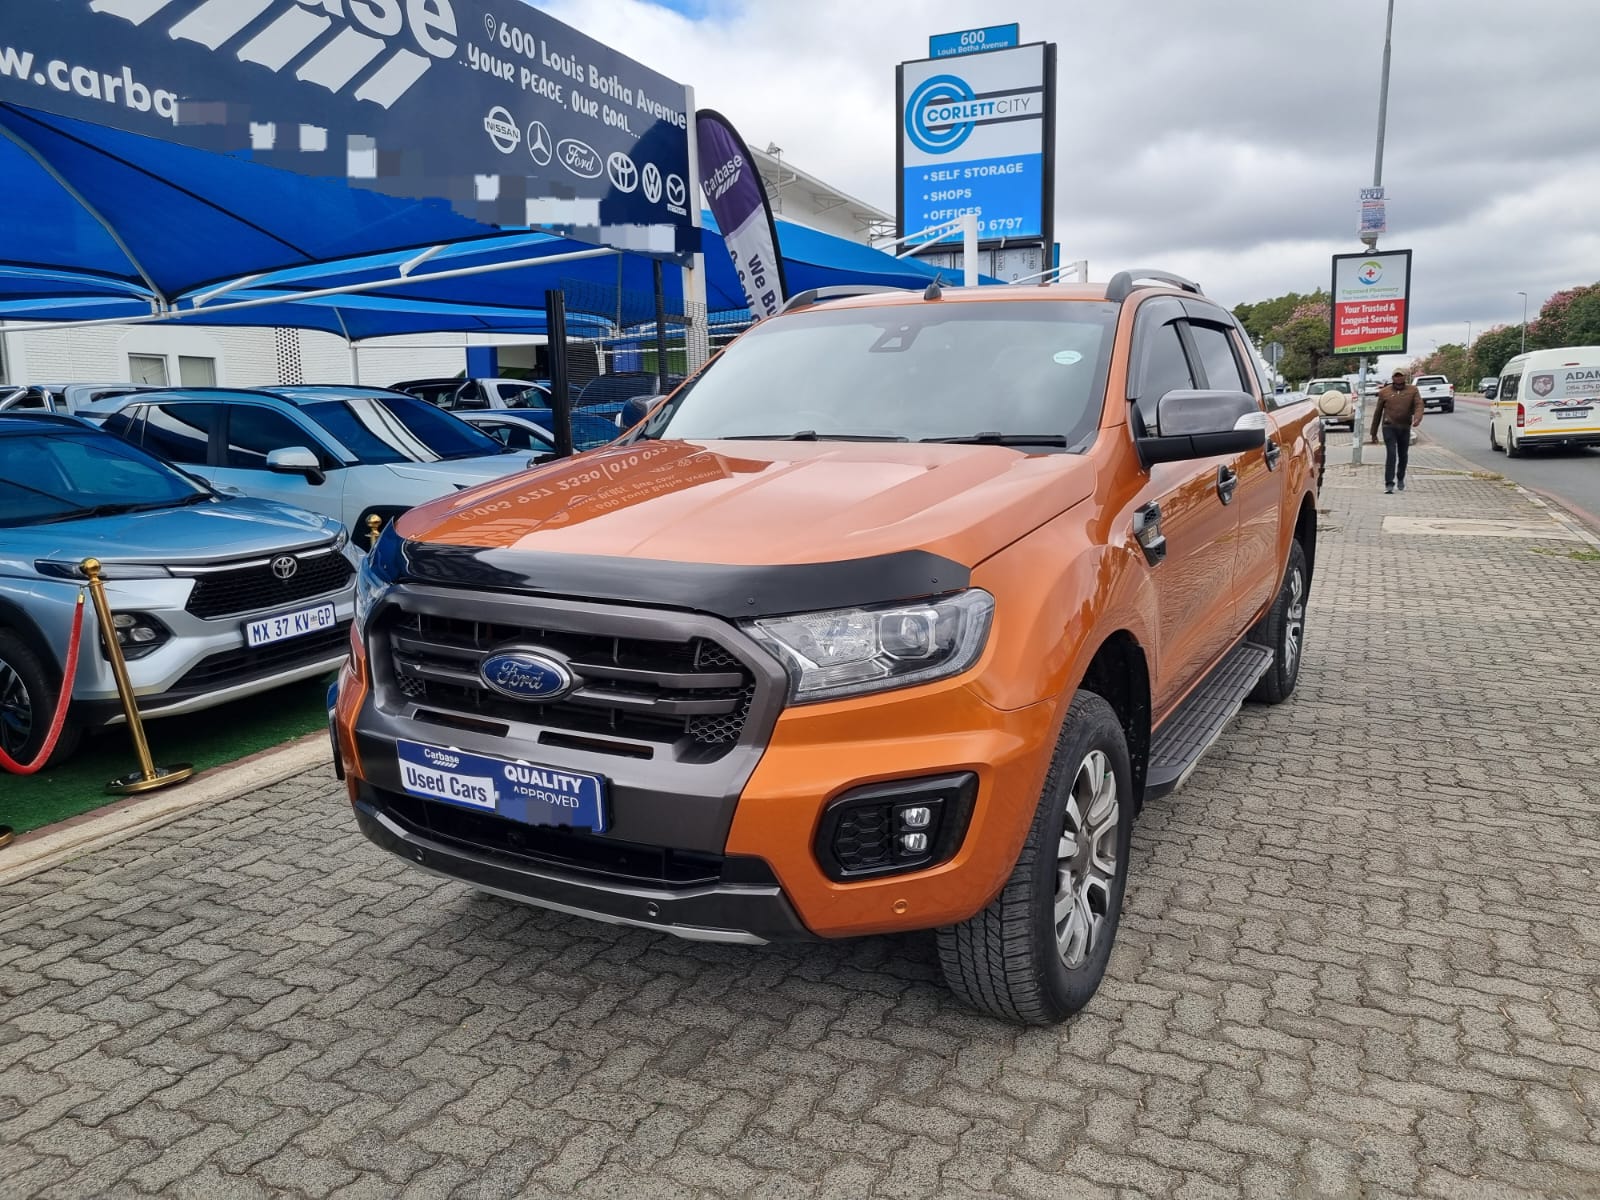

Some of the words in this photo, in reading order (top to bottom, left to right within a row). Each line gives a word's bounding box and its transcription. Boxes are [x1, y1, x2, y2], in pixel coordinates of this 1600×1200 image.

[937, 48, 956, 56] Louis
[958, 45, 979, 54] Botha
[981, 40, 1009, 49] Avenue
[960, 30, 985, 45] 600
[499, 22, 536, 59] 600
[541, 41, 585, 83] Louis
[589, 64, 633, 105] Botha
[636, 89, 687, 130] Avenue
[520, 68, 568, 110] PEACE,
[571, 91, 599, 119] OUR
[486, 120, 520, 143] NISSAN
[565, 144, 596, 173] Ford
[704, 154, 743, 197] Carbase
[930, 170, 960, 182] SELF
[964, 162, 1023, 179] STORAGE
[930, 188, 972, 202] SHOPS
[930, 206, 982, 221] OFFICES
[989, 217, 1023, 231] 6797
[748, 254, 766, 289] We
[1344, 304, 1360, 314] Your
[1361, 303, 1389, 313] Trusted
[1389, 302, 1396, 311] &
[1341, 315, 1369, 326] Longest
[1370, 314, 1399, 324] Serving
[1341, 327, 1360, 336] Local
[1361, 326, 1398, 335] Pharmacy
[252, 622, 270, 642] MX
[275, 618, 289, 637] 37
[295, 613, 309, 633] KV
[317, 607, 331, 626] GP
[496, 660, 544, 690] Ford
[424, 748, 460, 765] Carbase
[406, 766, 445, 793] Used
[449, 776, 487, 802] Cars
[504, 765, 582, 794] QUALITY
[513, 785, 579, 808] APPROVED
